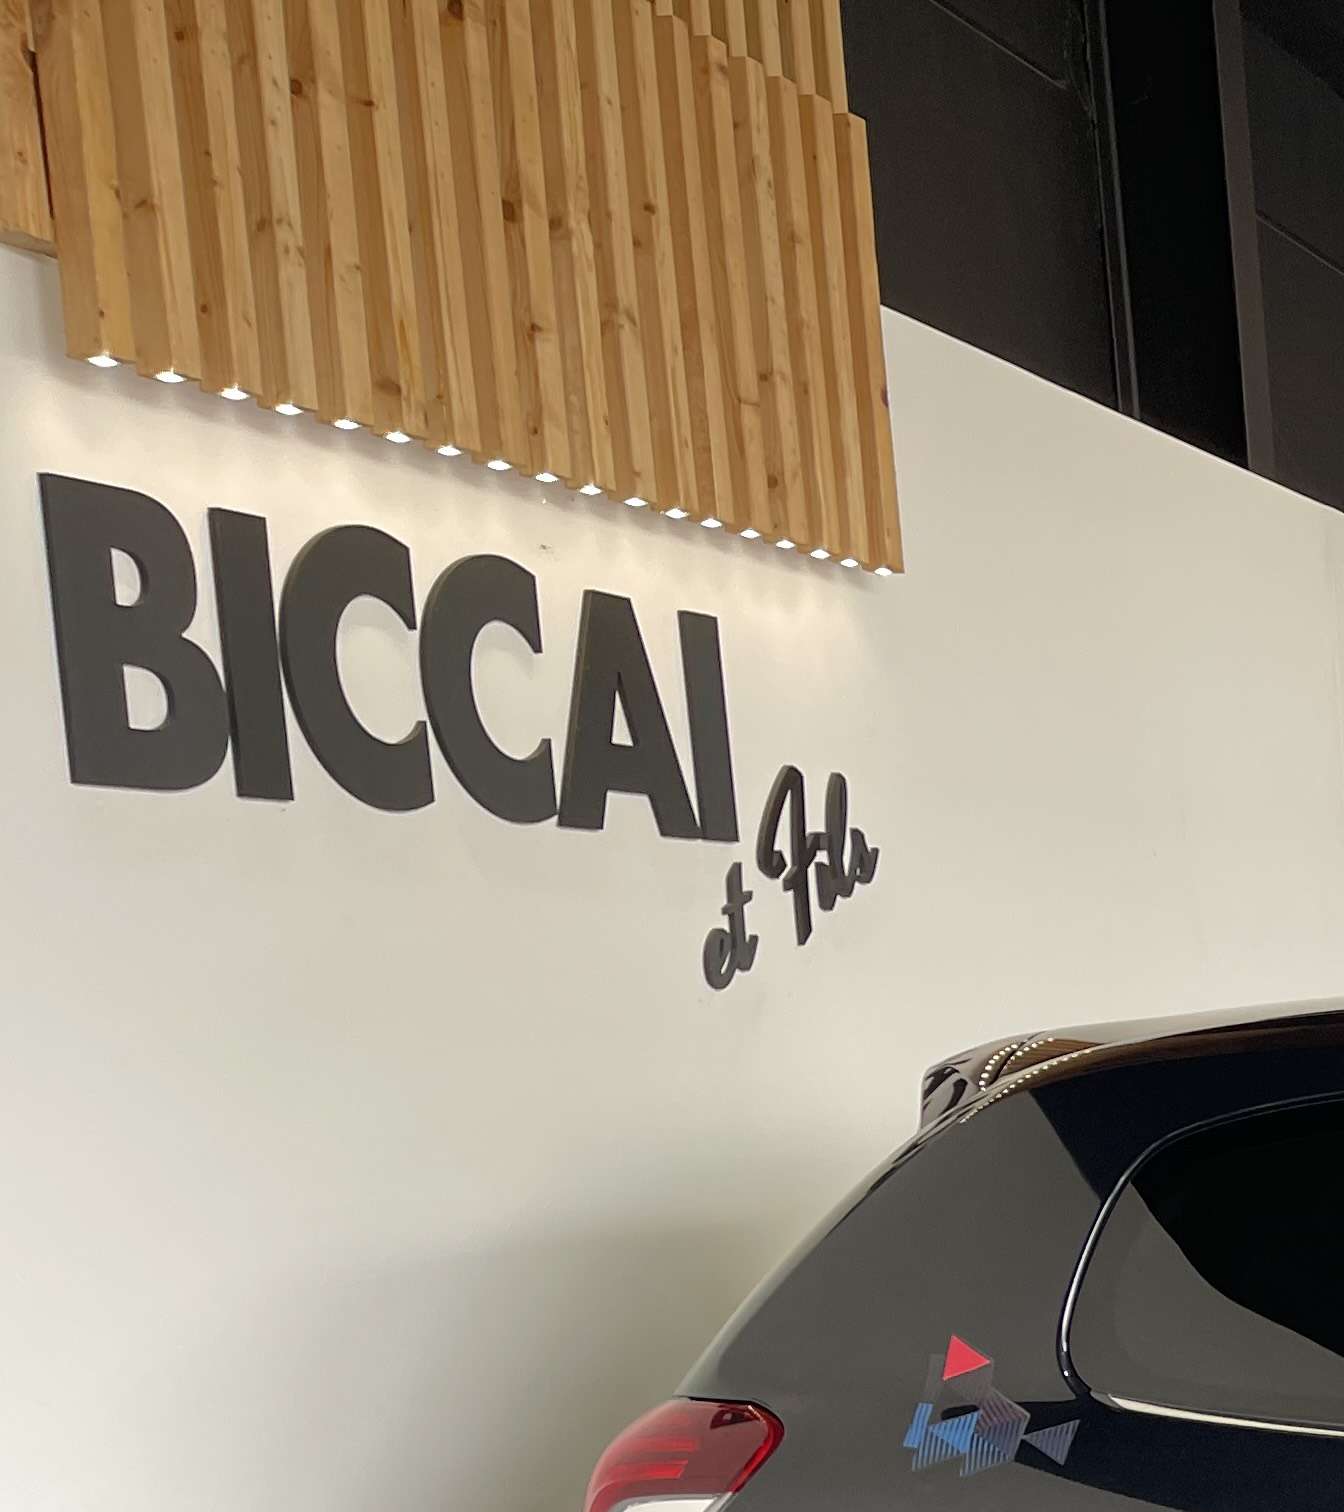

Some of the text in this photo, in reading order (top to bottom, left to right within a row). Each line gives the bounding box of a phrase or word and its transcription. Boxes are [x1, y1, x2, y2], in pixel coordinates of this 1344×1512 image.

[37, 473, 740, 842] BICCAI
[703, 764, 880, 990] et Fils
